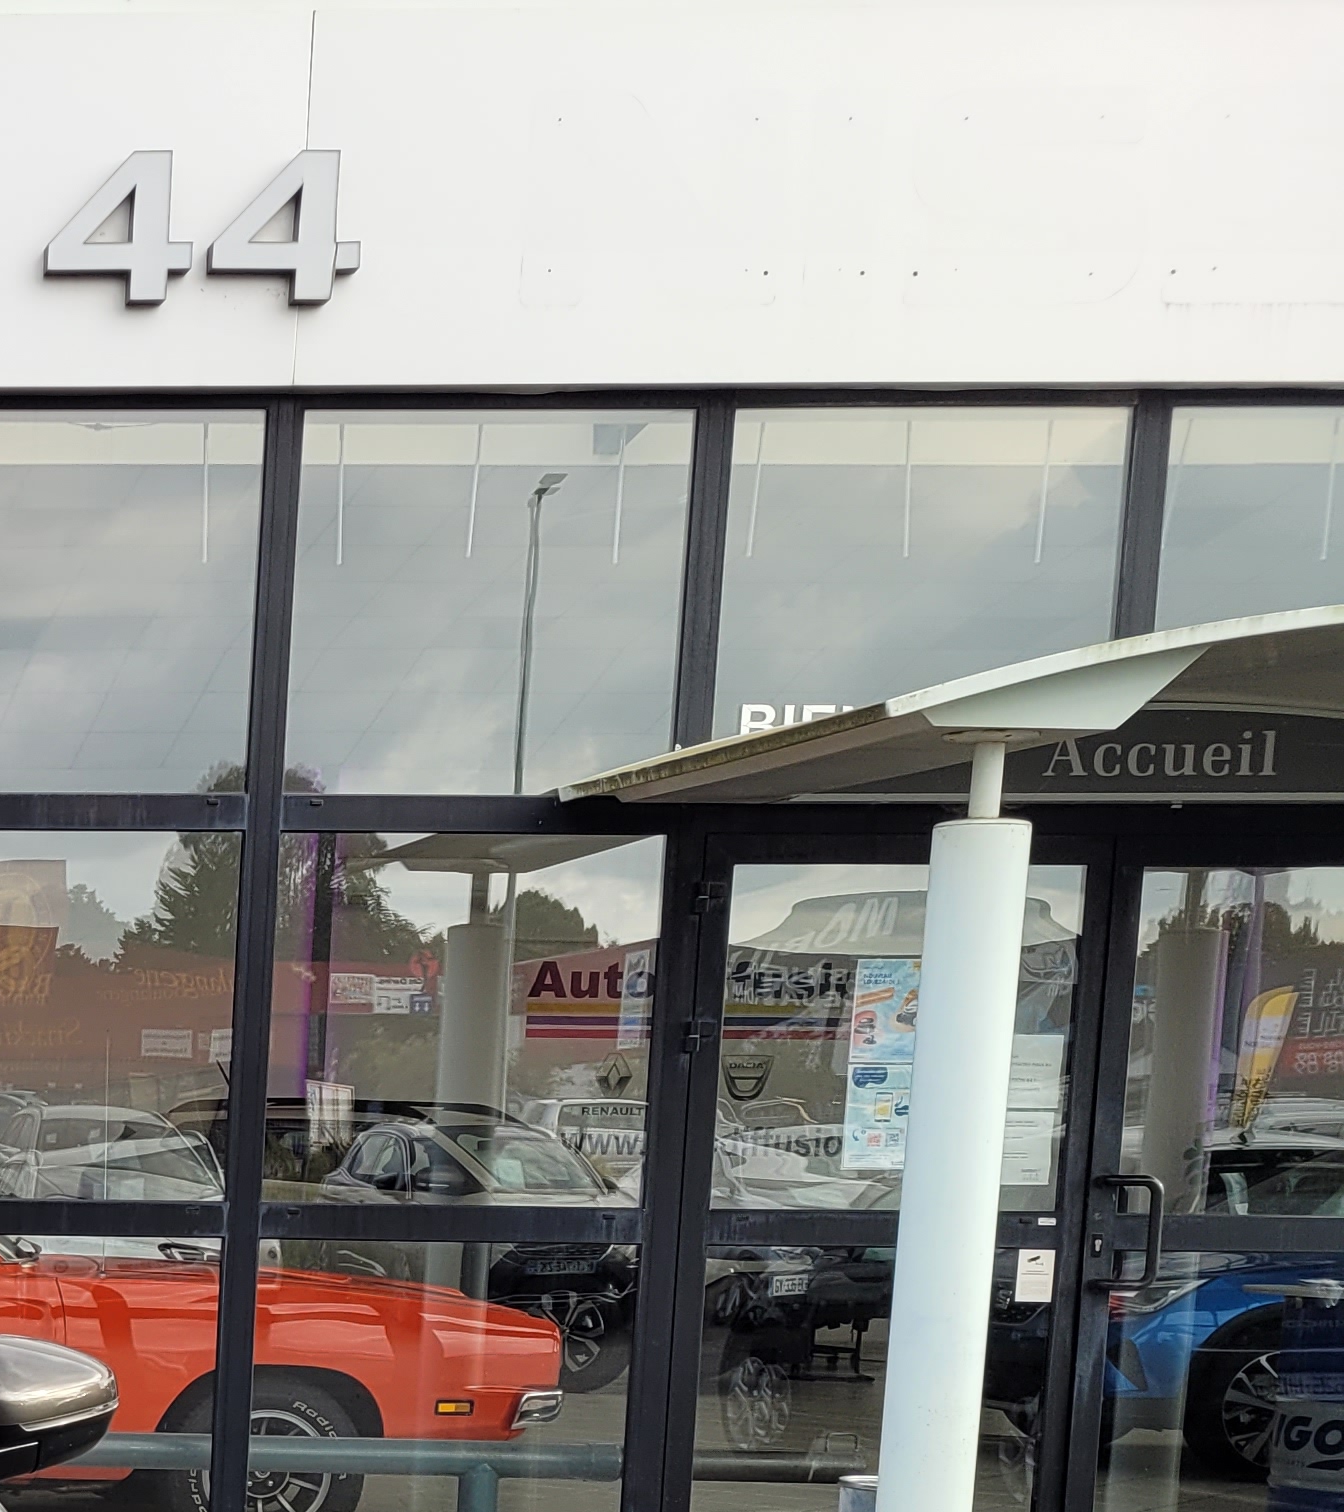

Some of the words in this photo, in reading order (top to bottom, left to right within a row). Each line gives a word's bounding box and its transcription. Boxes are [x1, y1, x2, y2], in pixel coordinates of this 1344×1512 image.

[43, 149, 360, 308] 44
[1042, 730, 1277, 777] Accueil
[581, 1106, 644, 1117] RENAULT
